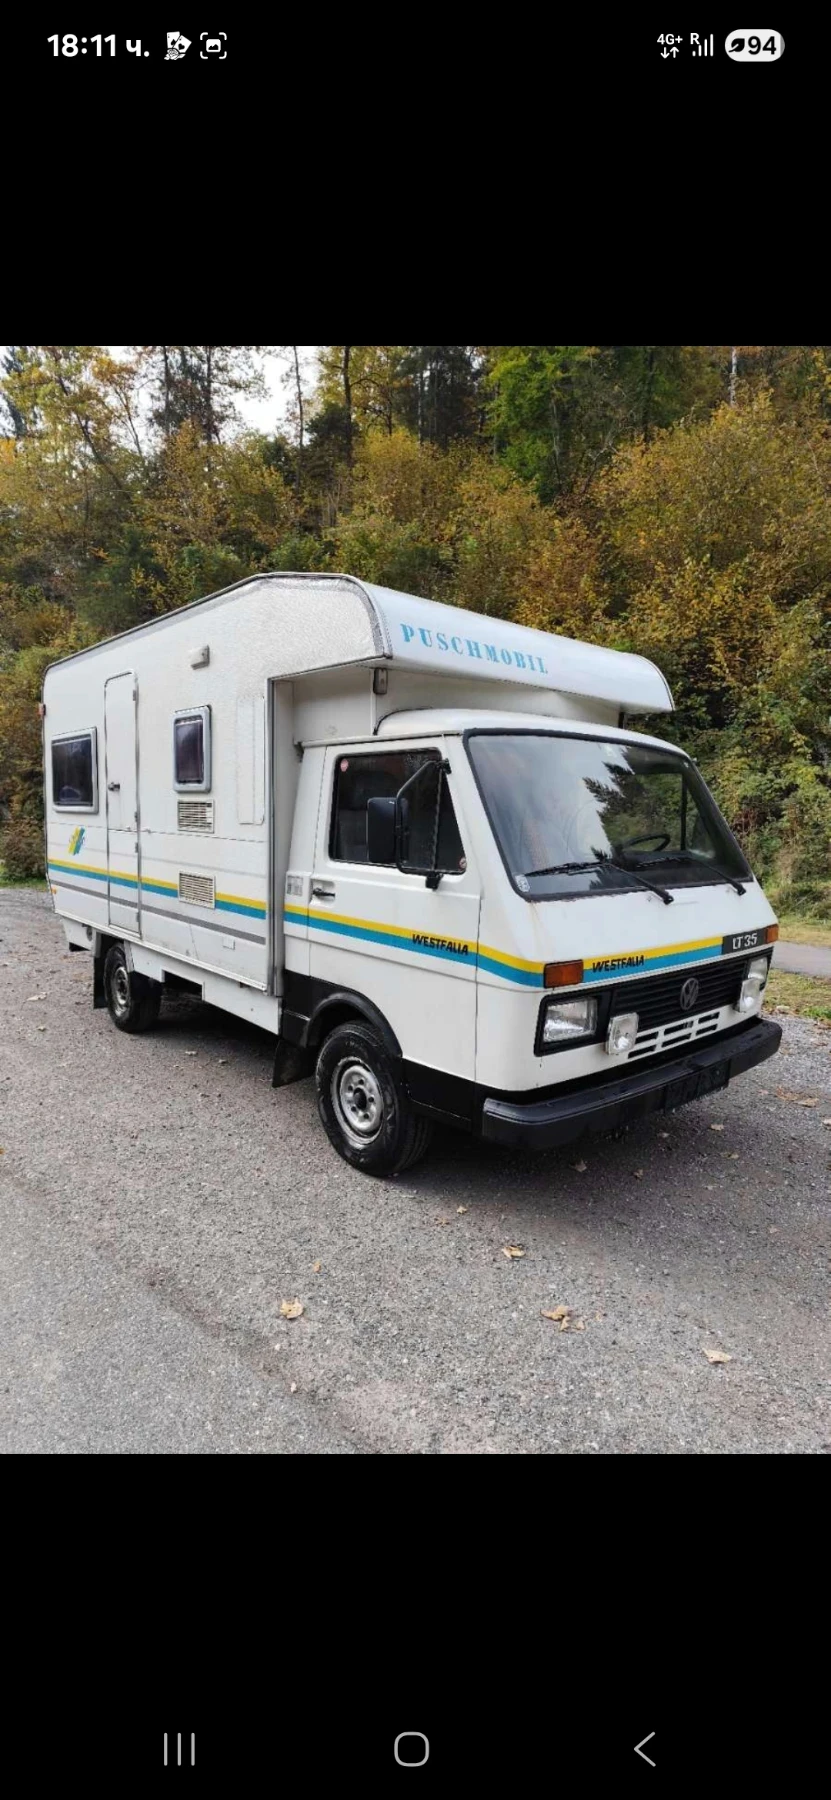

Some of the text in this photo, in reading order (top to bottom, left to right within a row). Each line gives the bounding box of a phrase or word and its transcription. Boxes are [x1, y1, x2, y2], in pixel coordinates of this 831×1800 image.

[400, 623, 549, 674] PUSCHMOBIL
[412, 933, 469, 956] WESTFALIA
[732, 932, 758, 950] LT 35
[592, 954, 645, 973] WESTFALIA
